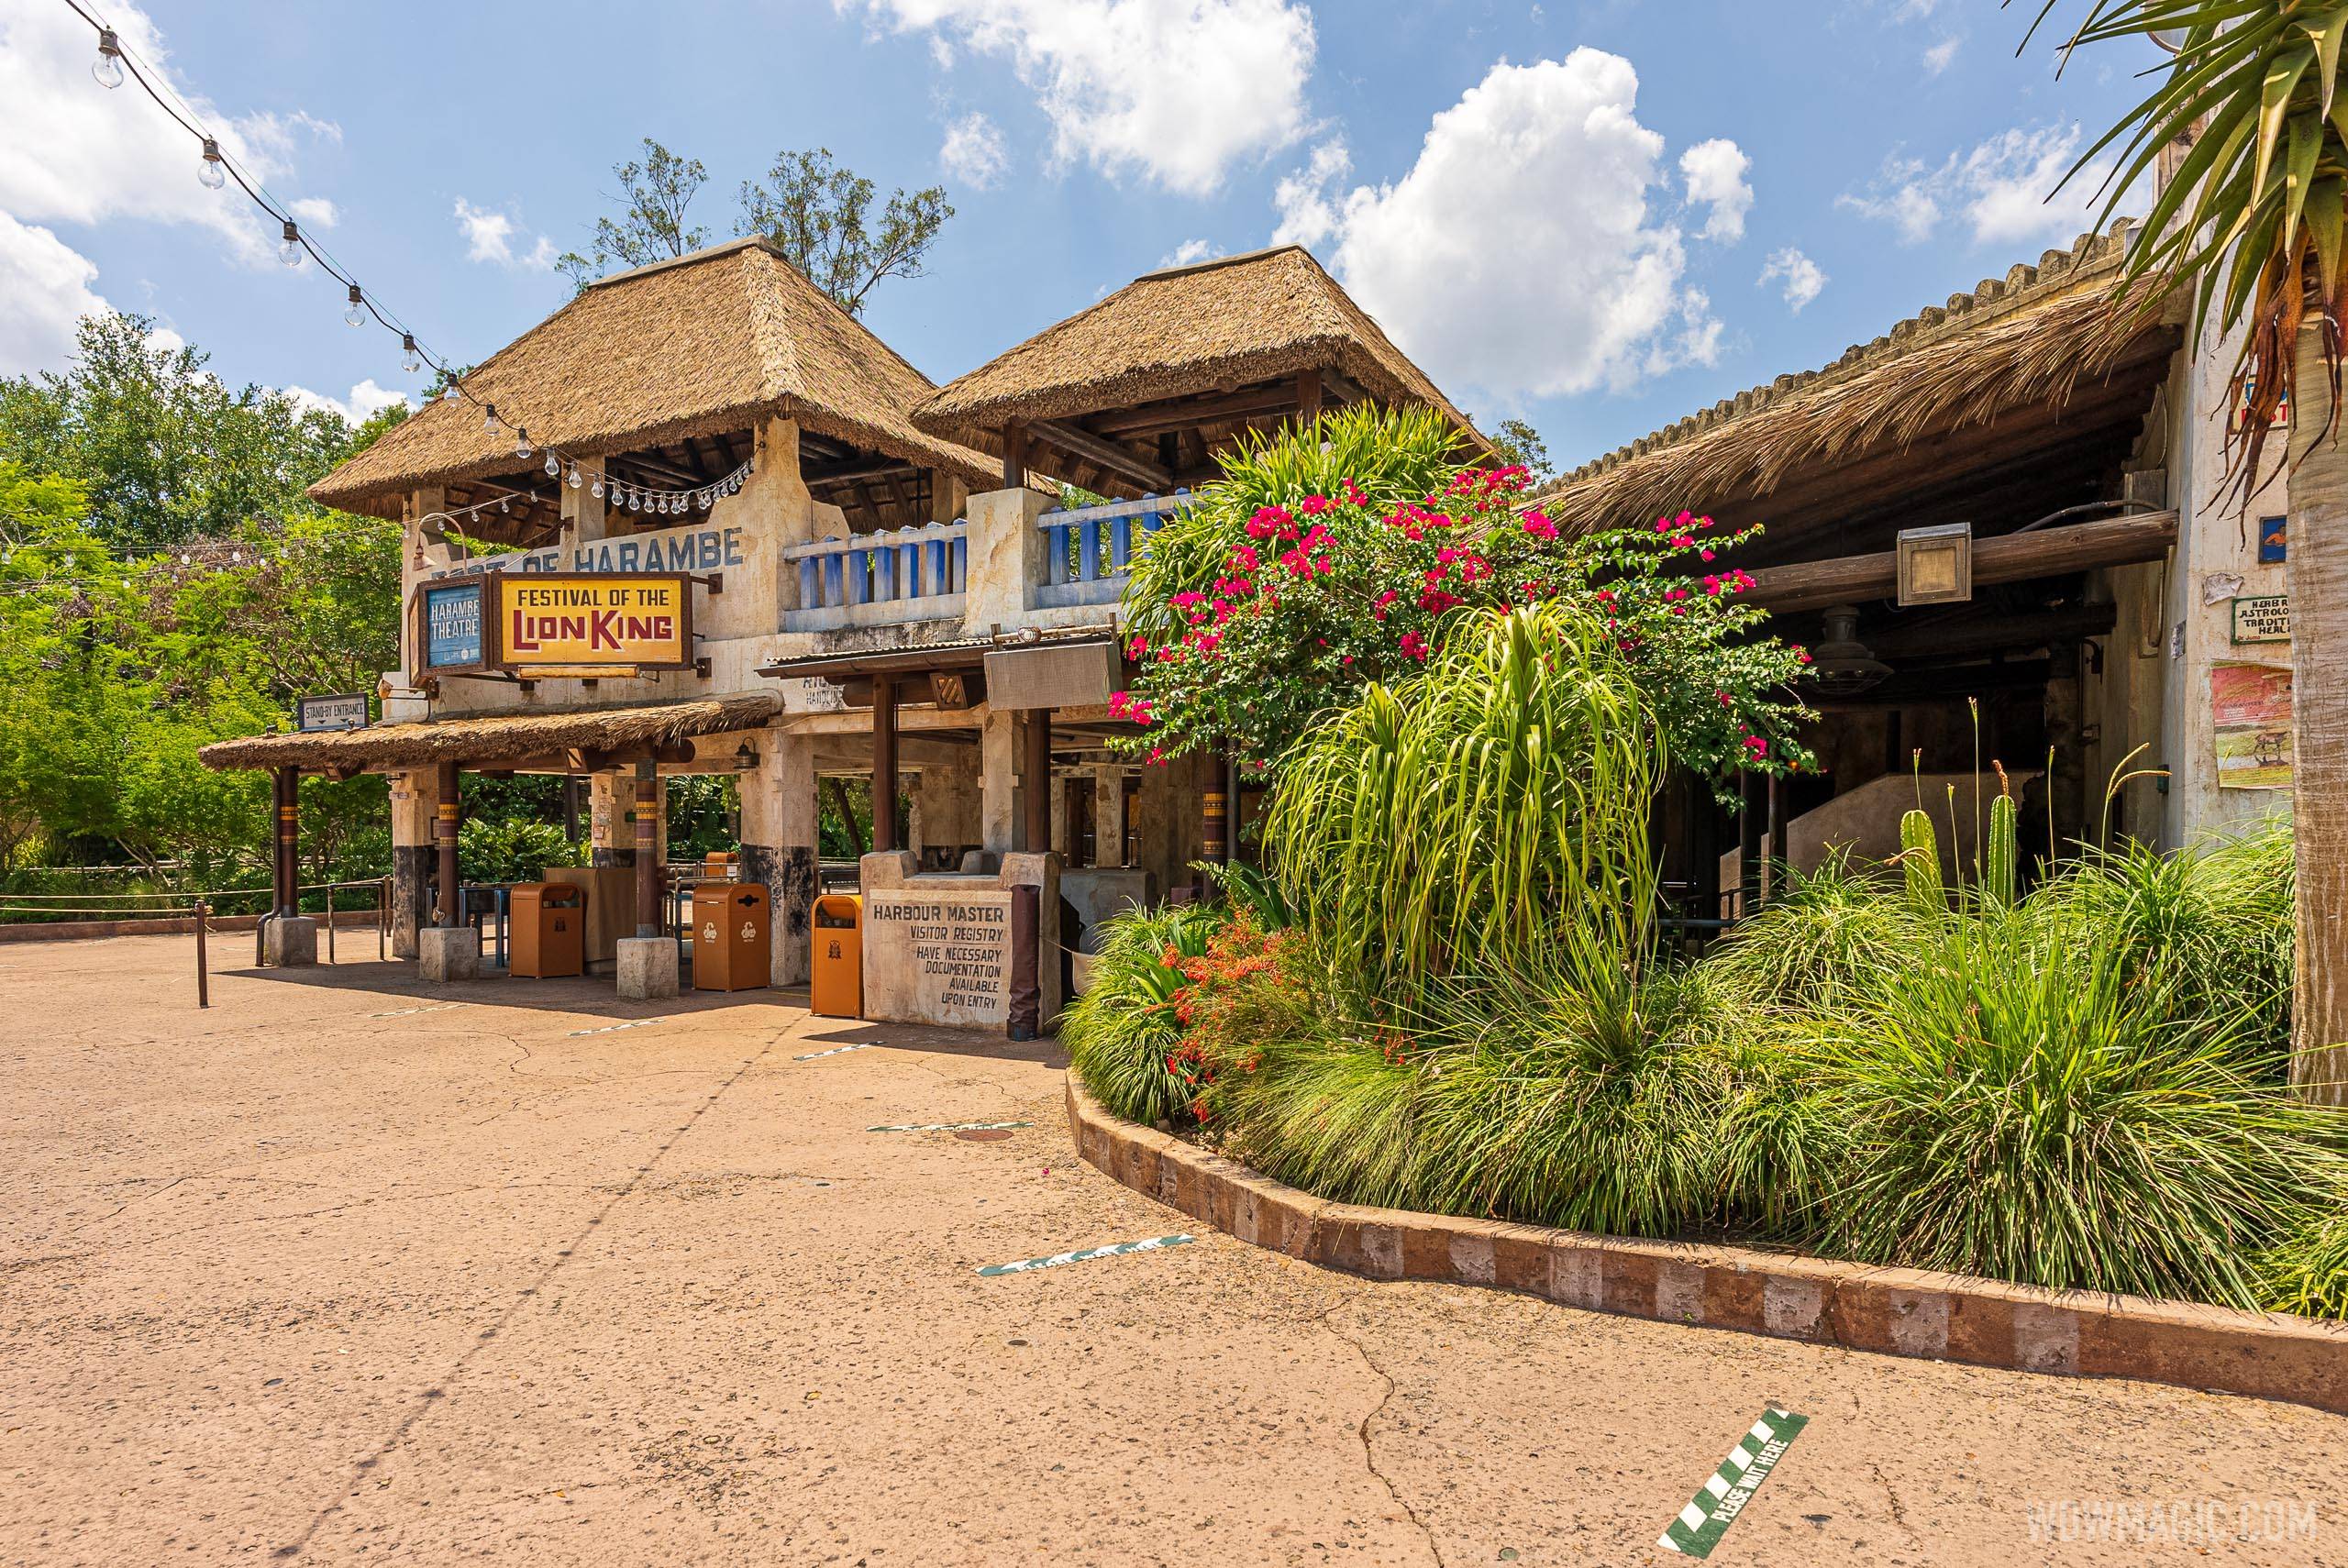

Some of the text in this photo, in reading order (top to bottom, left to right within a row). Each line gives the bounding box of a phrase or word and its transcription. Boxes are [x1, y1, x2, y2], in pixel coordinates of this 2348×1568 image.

[574, 527, 744, 573] HARAMBE
[518, 590, 670, 607] FESTIVAL OF THE
[431, 600, 480, 621] HARAMBE
[432, 619, 479, 640] THEATRE
[305, 702, 363, 719] STAND-BY ENTRANCE
[873, 905, 1004, 922] HARBOUR MASTER
[910, 925, 1004, 942] VISITOR REGISTRY
[916, 946, 1002, 962] HAVE NECESSARY
[925, 960, 1002, 977] DOCUMENTATION
[949, 977, 999, 993] AVAILABLE
[941, 992, 997, 1010] UPON ENTRY
[1711, 1438, 1789, 1523] PLEASE WAIT HERE
